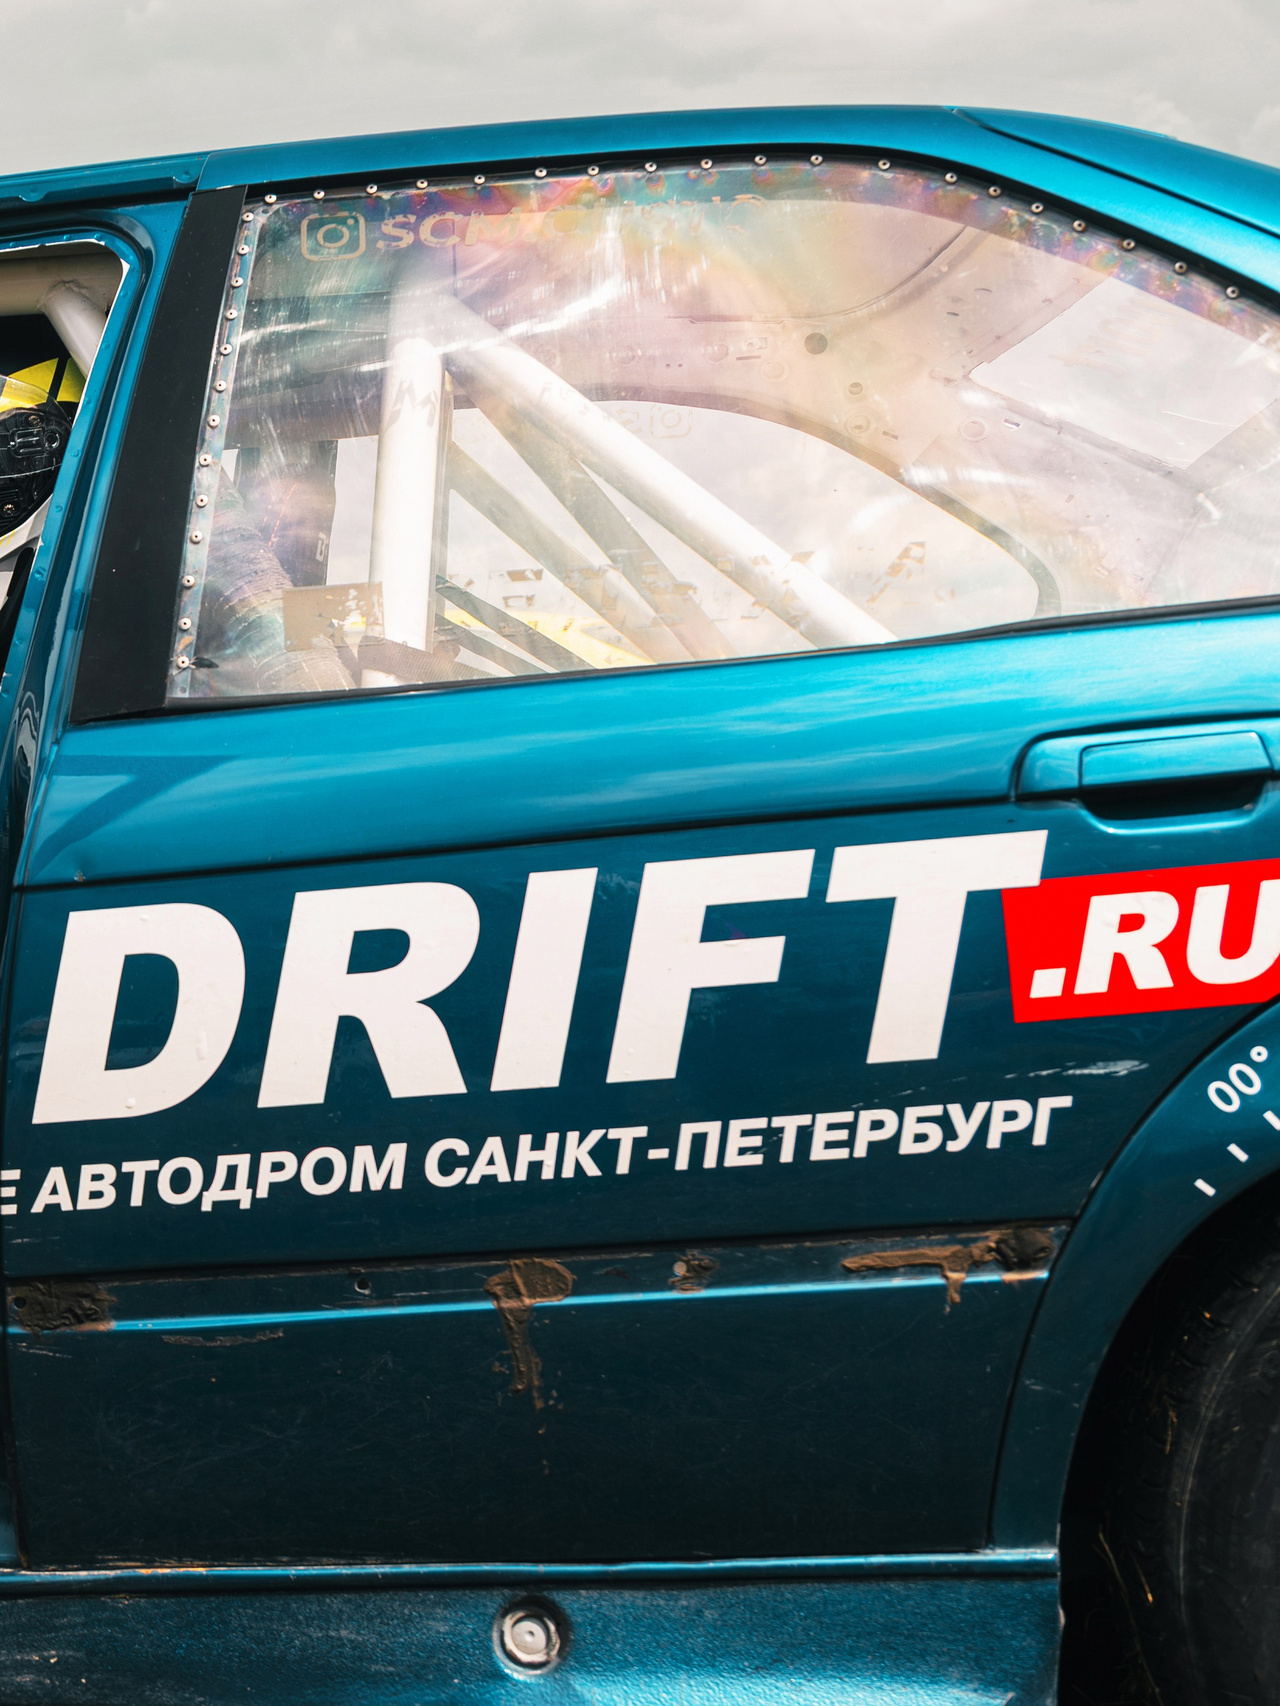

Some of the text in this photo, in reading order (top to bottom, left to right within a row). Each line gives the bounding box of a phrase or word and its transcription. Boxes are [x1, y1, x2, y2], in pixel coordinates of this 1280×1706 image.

[31, 829, 1049, 1125] DRIFT
[30, 1143, 408, 1213] АВТОДРОМ
[424, 1095, 1073, 1188] САНКТ-ПЕТЕРБУРГ
